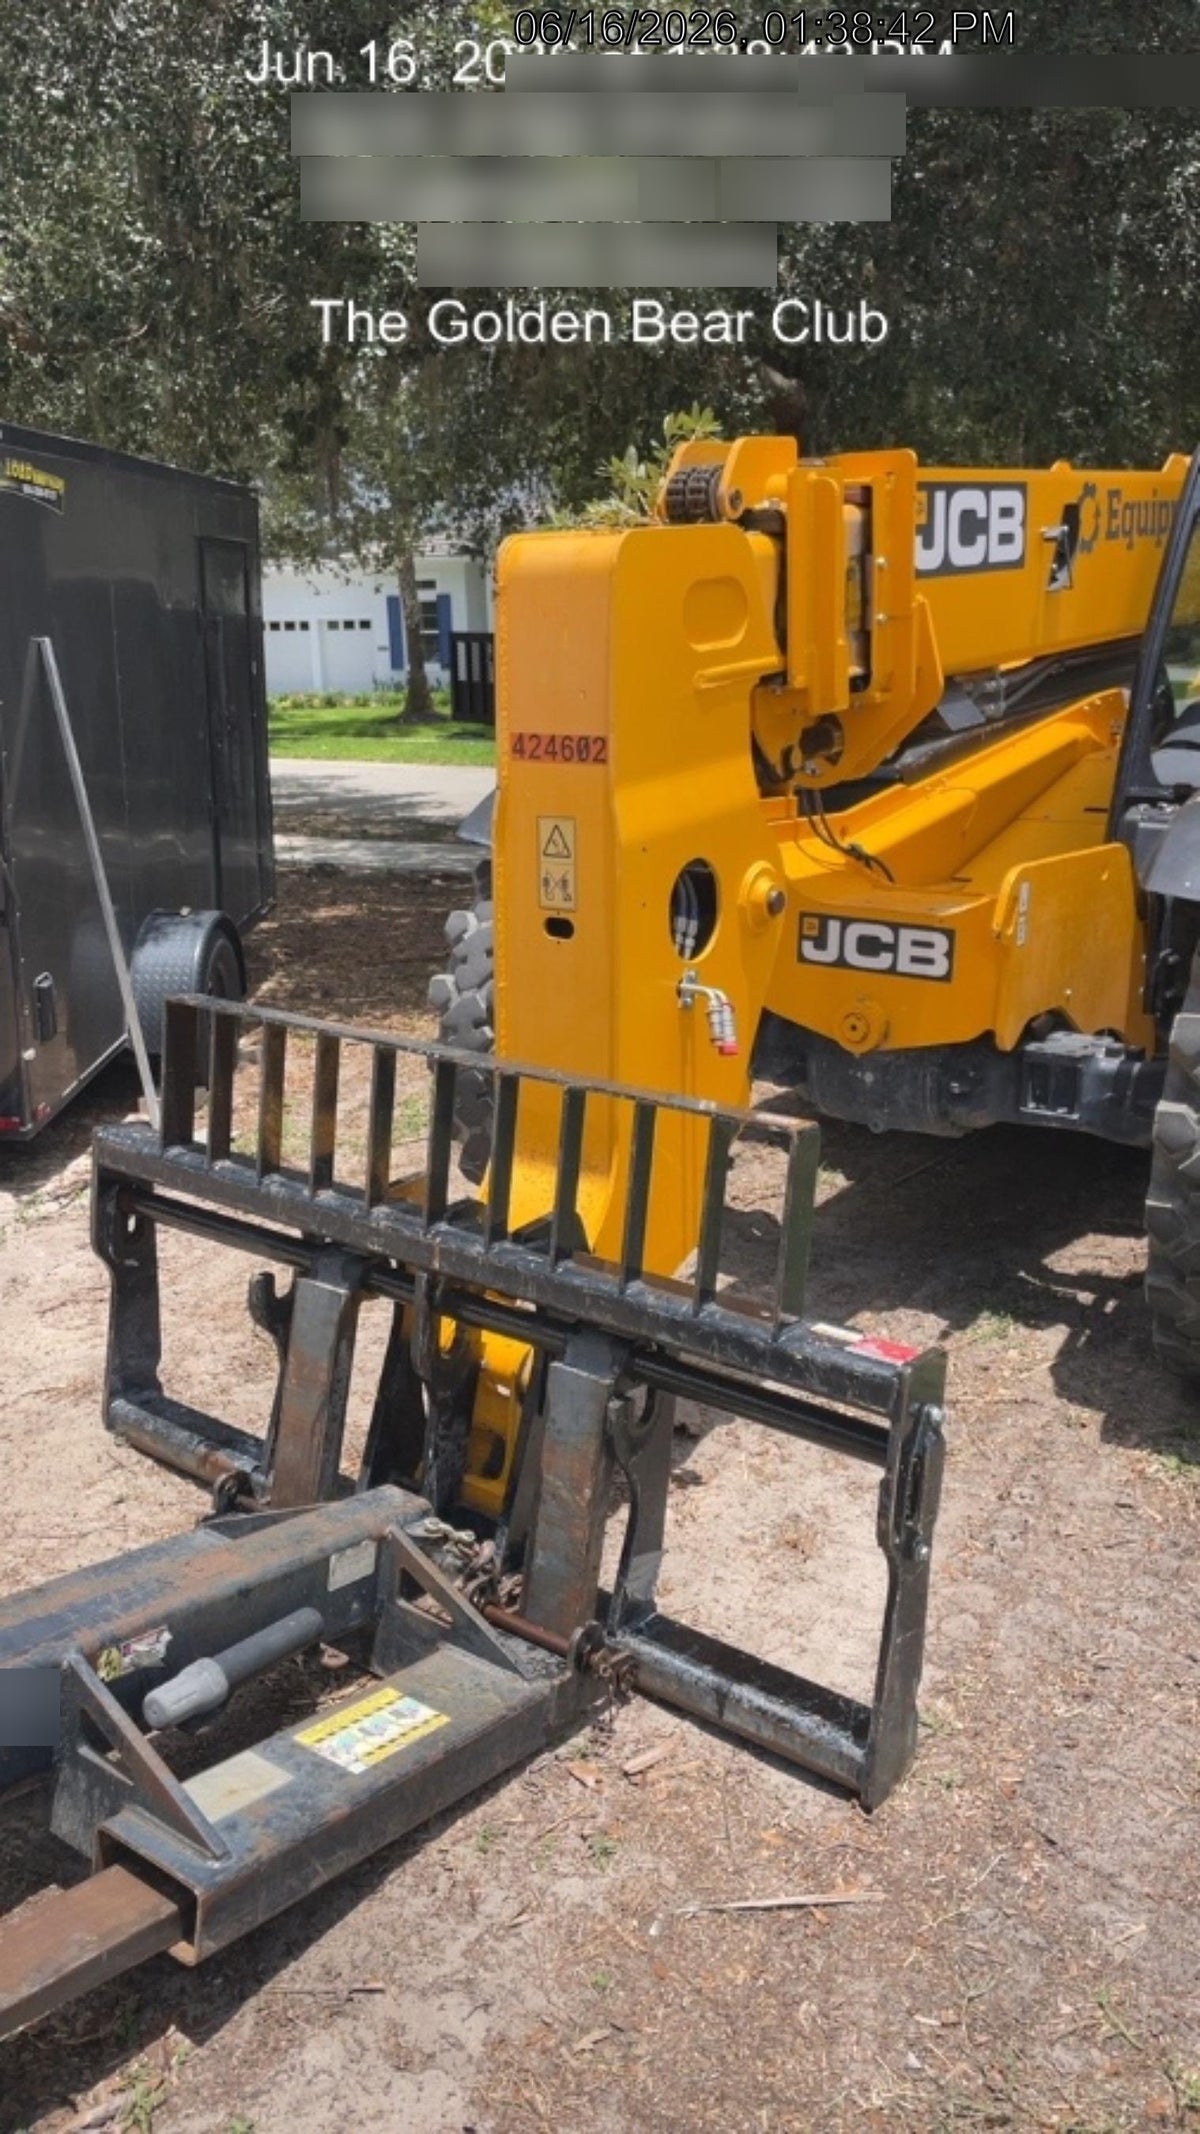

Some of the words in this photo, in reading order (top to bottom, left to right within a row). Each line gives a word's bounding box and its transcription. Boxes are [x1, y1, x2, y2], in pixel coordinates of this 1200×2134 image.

[915, 488, 1024, 571] JCB
[1106, 488, 1179, 551] Equip
[511, 733, 608, 765] 424602
[800, 918, 950, 978] JCB
